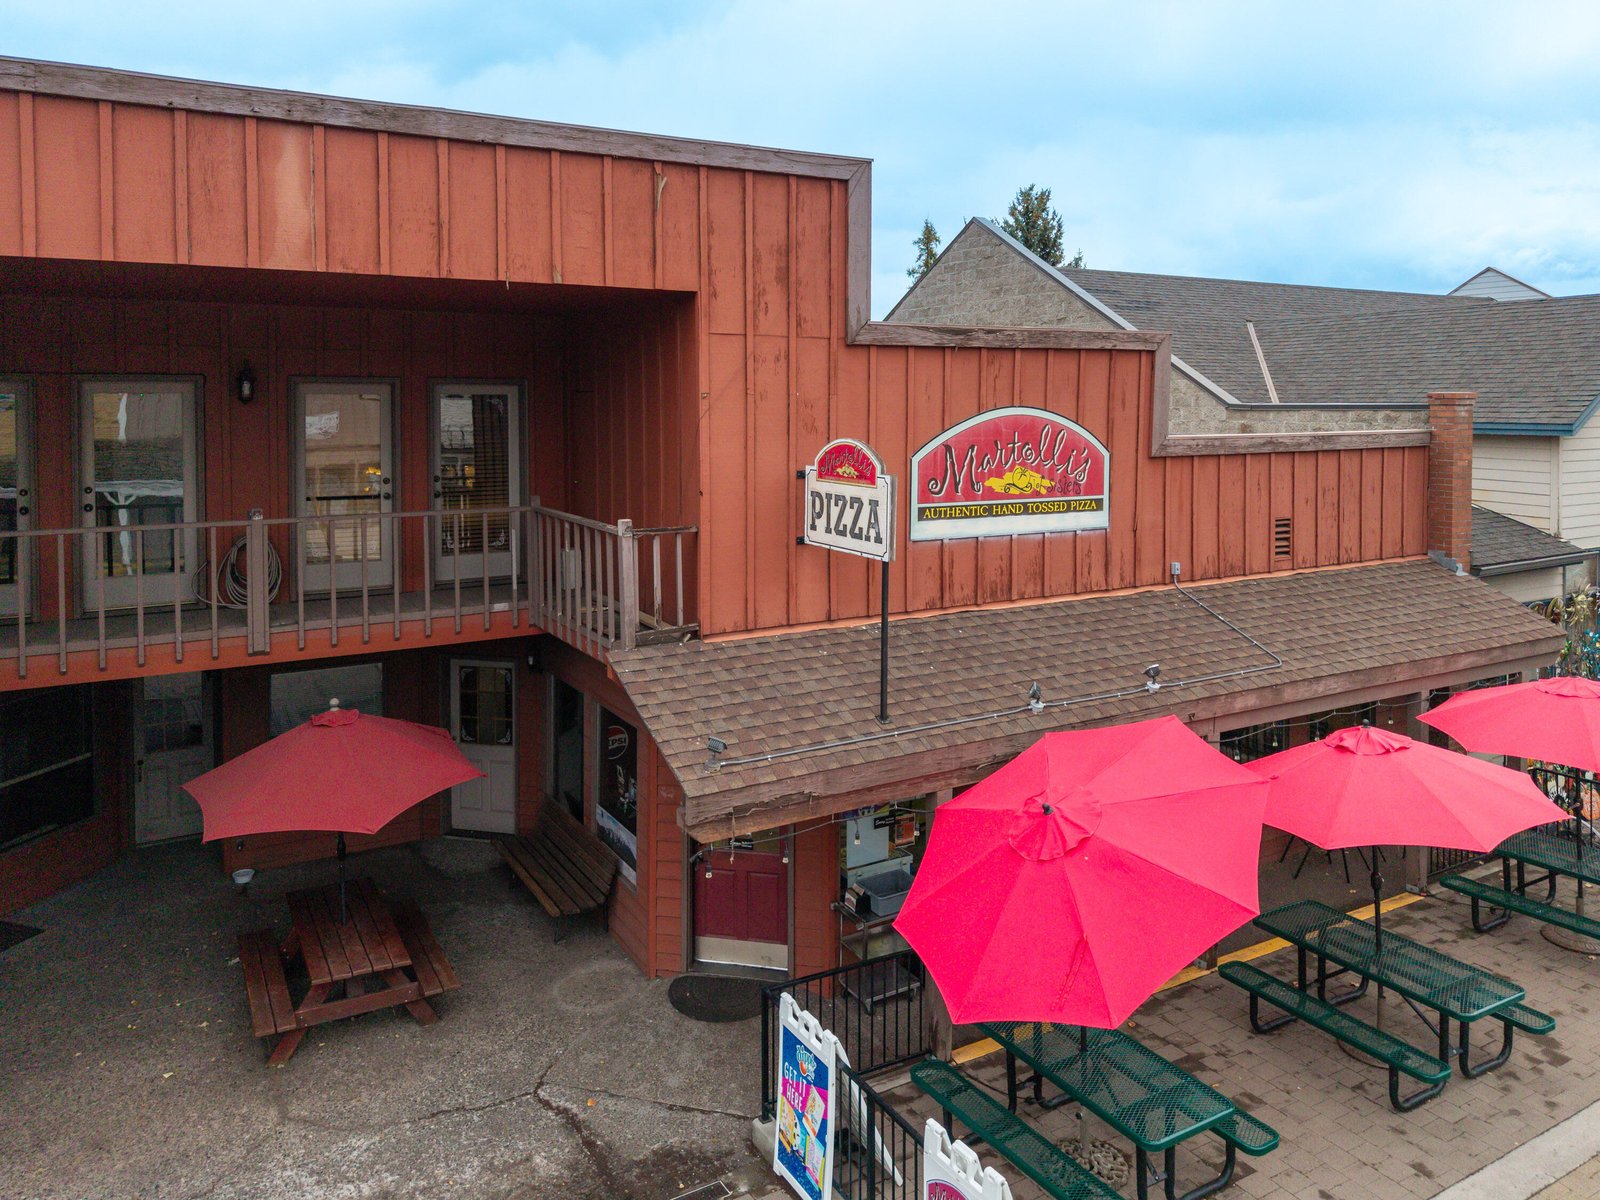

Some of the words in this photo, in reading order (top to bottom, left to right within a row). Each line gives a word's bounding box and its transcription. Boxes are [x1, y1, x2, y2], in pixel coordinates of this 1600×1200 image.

[928, 424, 1091, 496] Martolli's
[1046, 475, 1082, 495] Sisters
[810, 491, 882, 544] PIZZA
[923, 505, 989, 519] AUTHENTIC
[992, 503, 1024, 515] HAND
[1027, 501, 1067, 513] TOSSED
[1070, 500, 1097, 511] PIZZA
[784, 1062, 797, 1088] GET
[799, 1077, 807, 1097] IT
[786, 1083, 803, 1113] HERE
